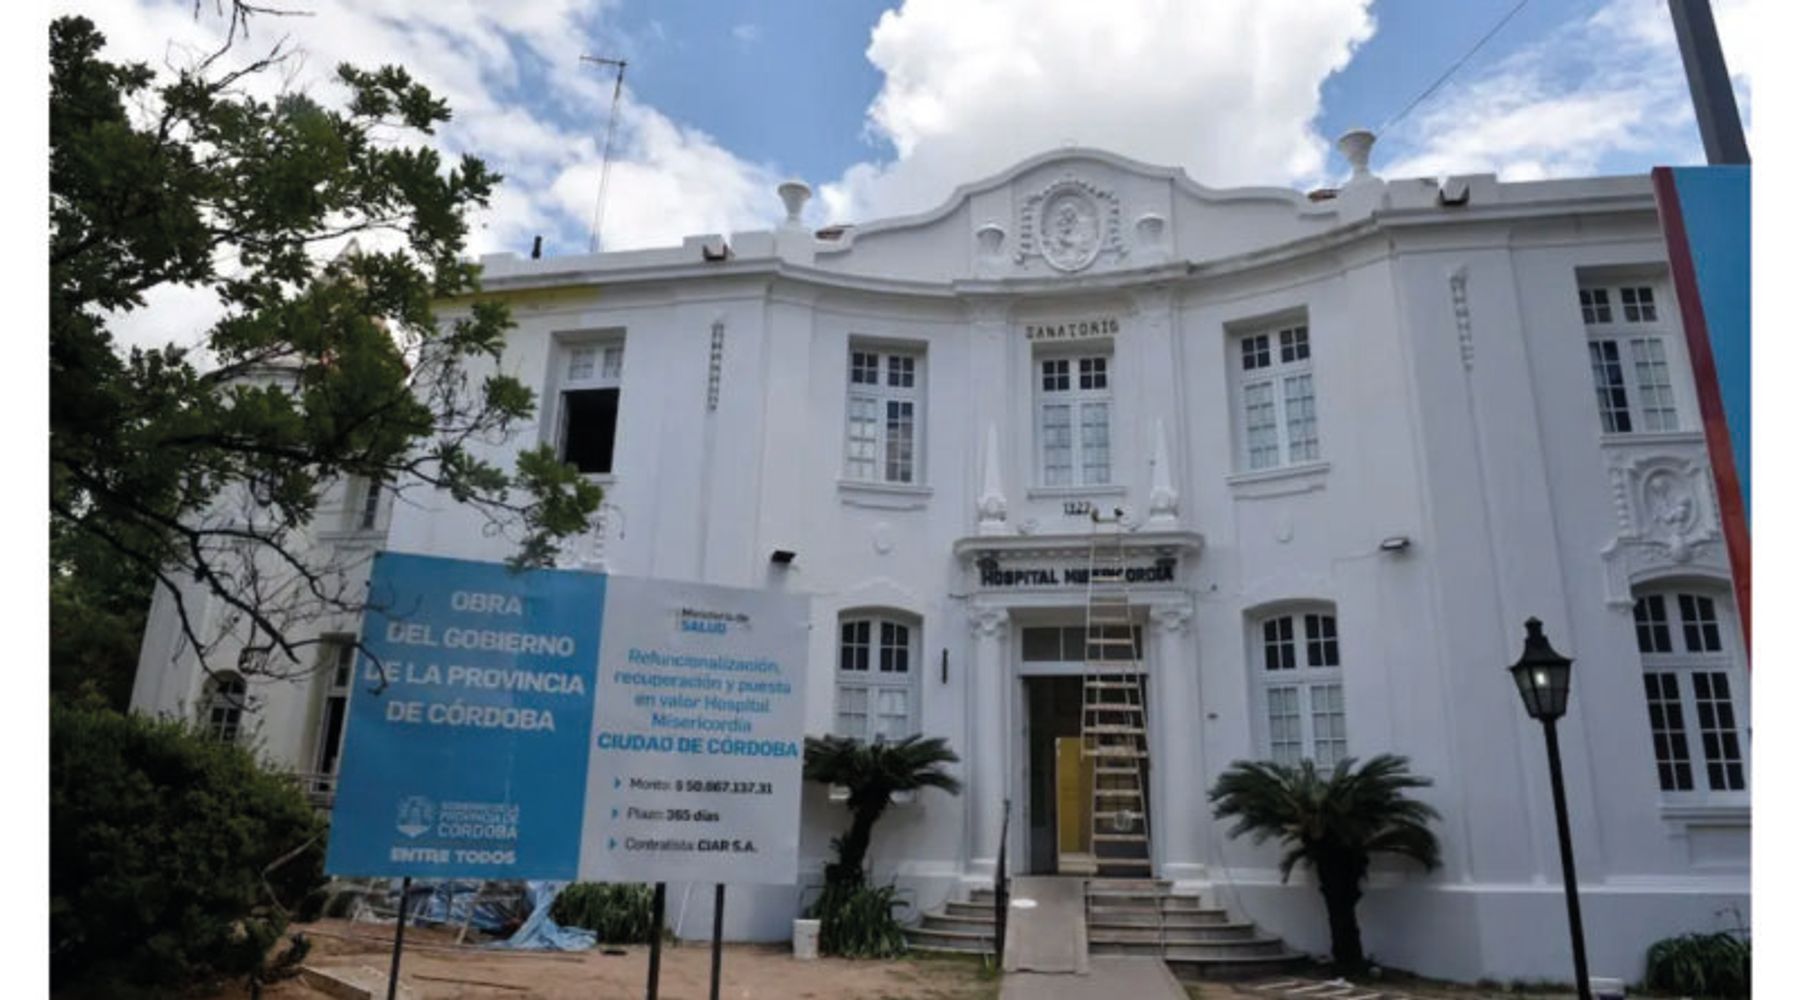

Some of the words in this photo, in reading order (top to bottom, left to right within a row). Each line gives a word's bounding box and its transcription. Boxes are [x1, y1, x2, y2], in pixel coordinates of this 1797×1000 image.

[1025, 319, 1119, 339] SANATORIO
[981, 569, 1059, 586] HOSPITAL
[451, 590, 522, 615] OBRA
[681, 620, 727, 634] SALUD
[386, 621, 438, 647] DEL
[443, 627, 575, 657] GOBIERNO
[364, 661, 400, 682] DE
[406, 661, 441, 685] LA
[447, 665, 585, 695] PROVINCIA
[613, 671, 723, 692] recuperación
[726, 679, 734, 692] y
[738, 680, 792, 695] puesta
[386, 700, 423, 723] DE
[427, 698, 555, 731] CÓRDOBA
[634, 695, 656, 706] en
[660, 694, 700, 709] valor
[704, 696, 771, 714] Hospital
[597, 732, 674, 751] CIUDAD
[678, 737, 702, 754] DE
[666, 809, 691, 822] 365
[390, 847, 450, 863] ENTRE
[453, 849, 517, 865] TODOS
